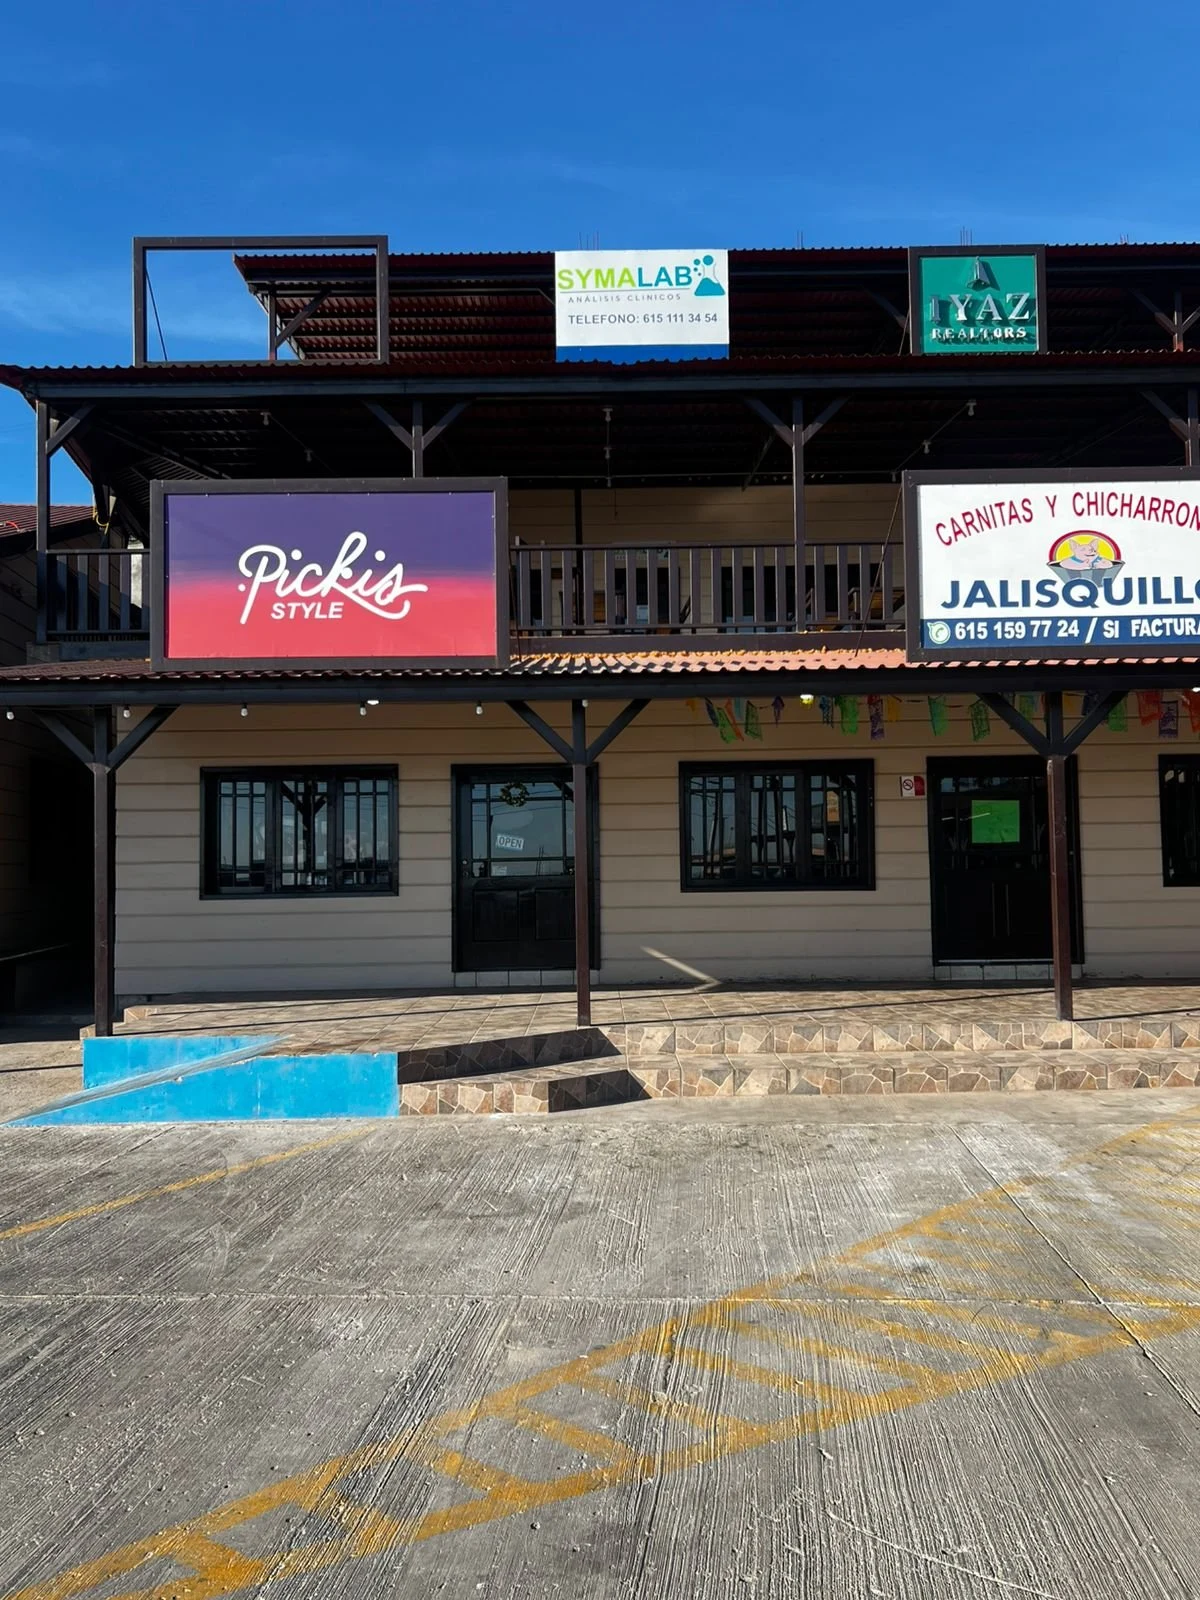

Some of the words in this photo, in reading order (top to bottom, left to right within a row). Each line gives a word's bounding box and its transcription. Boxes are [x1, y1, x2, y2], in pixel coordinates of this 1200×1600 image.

[557, 265, 693, 290] SYMALAB
[627, 293, 682, 302] CLINICOS
[568, 314, 640, 325] TELEFONO:
[643, 313, 663, 323] 615
[667, 313, 684, 323] 111
[689, 313, 701, 323] 34
[705, 312, 718, 323] 54
[931, 326, 1027, 340] REALTORS
[935, 498, 1033, 546] CARNITAS
[1045, 495, 1057, 518] Y
[238, 531, 428, 624] Pickis
[941, 576, 1200, 609] JALISQUILL
[271, 601, 344, 619] STYLE
[955, 621, 988, 640] 615
[993, 621, 1026, 640] 159
[1030, 620, 1051, 638] 77
[1057, 619, 1080, 638] 24
[1103, 622, 1119, 639] SI
[1131, 617, 1200, 638] FACTUR
[499, 836, 523, 849] OPEN
